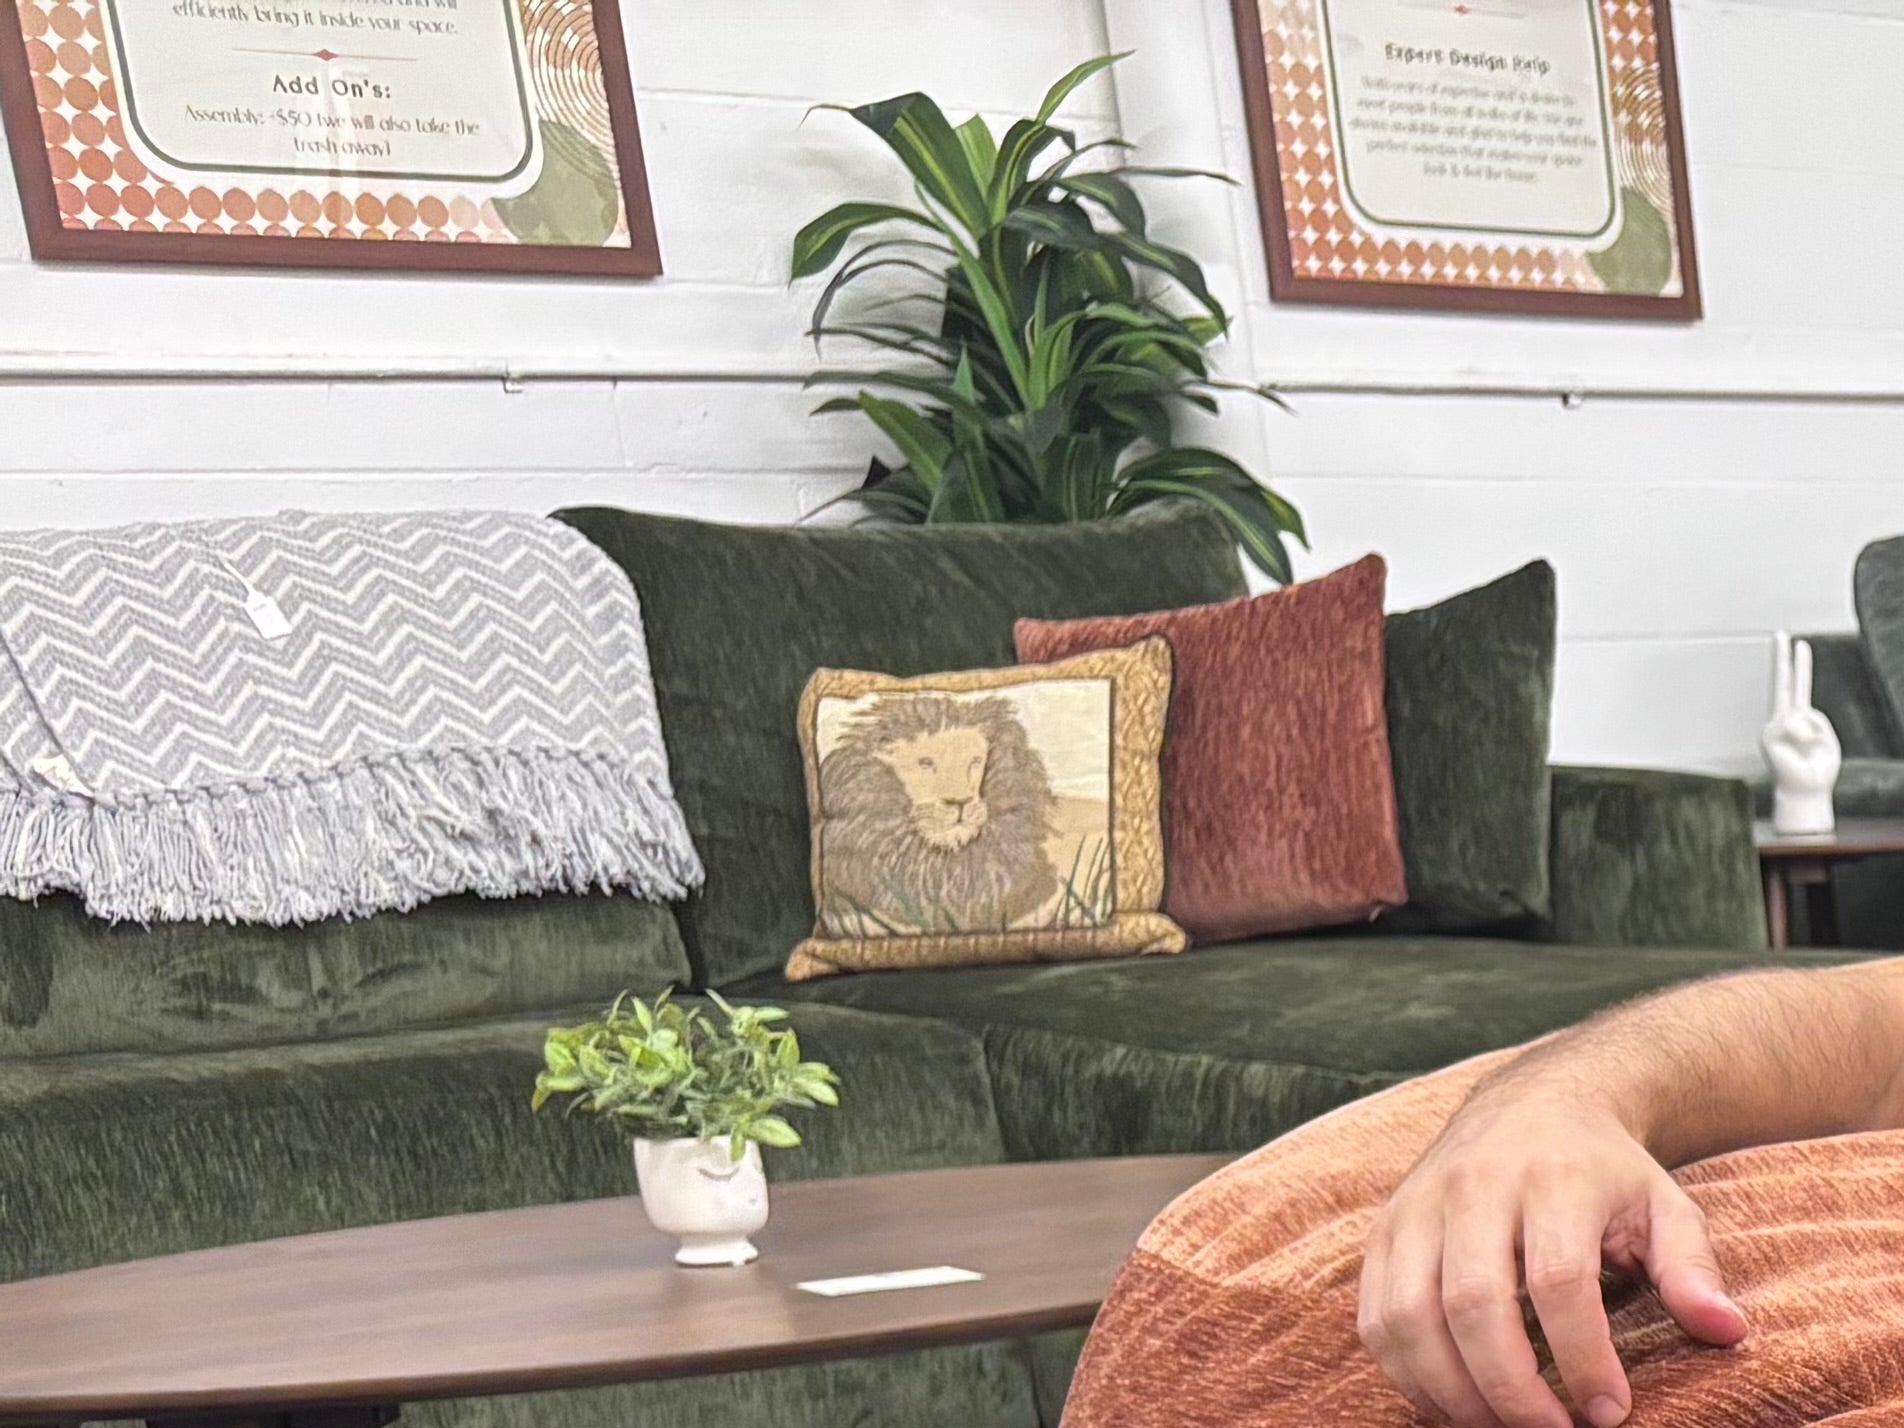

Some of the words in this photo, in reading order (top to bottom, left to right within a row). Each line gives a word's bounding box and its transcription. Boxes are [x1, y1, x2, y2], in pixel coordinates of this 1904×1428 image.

[253, 5, 299, 27] bring
[303, 10, 314, 25] it
[319, 10, 364, 28] inside
[367, 17, 401, 31] your
[408, 20, 458, 35] space.
[1385, 42, 1442, 64] Expert
[1449, 48, 1506, 71] Design
[273, 74, 320, 95] Add
[331, 79, 392, 98] On's:
[184, 104, 265, 126] Assembly:
[350, 114, 376, 129] will
[379, 116, 411, 133] also
[416, 117, 450, 134] take
[455, 119, 480, 136] the
[293, 136, 337, 154] trash
